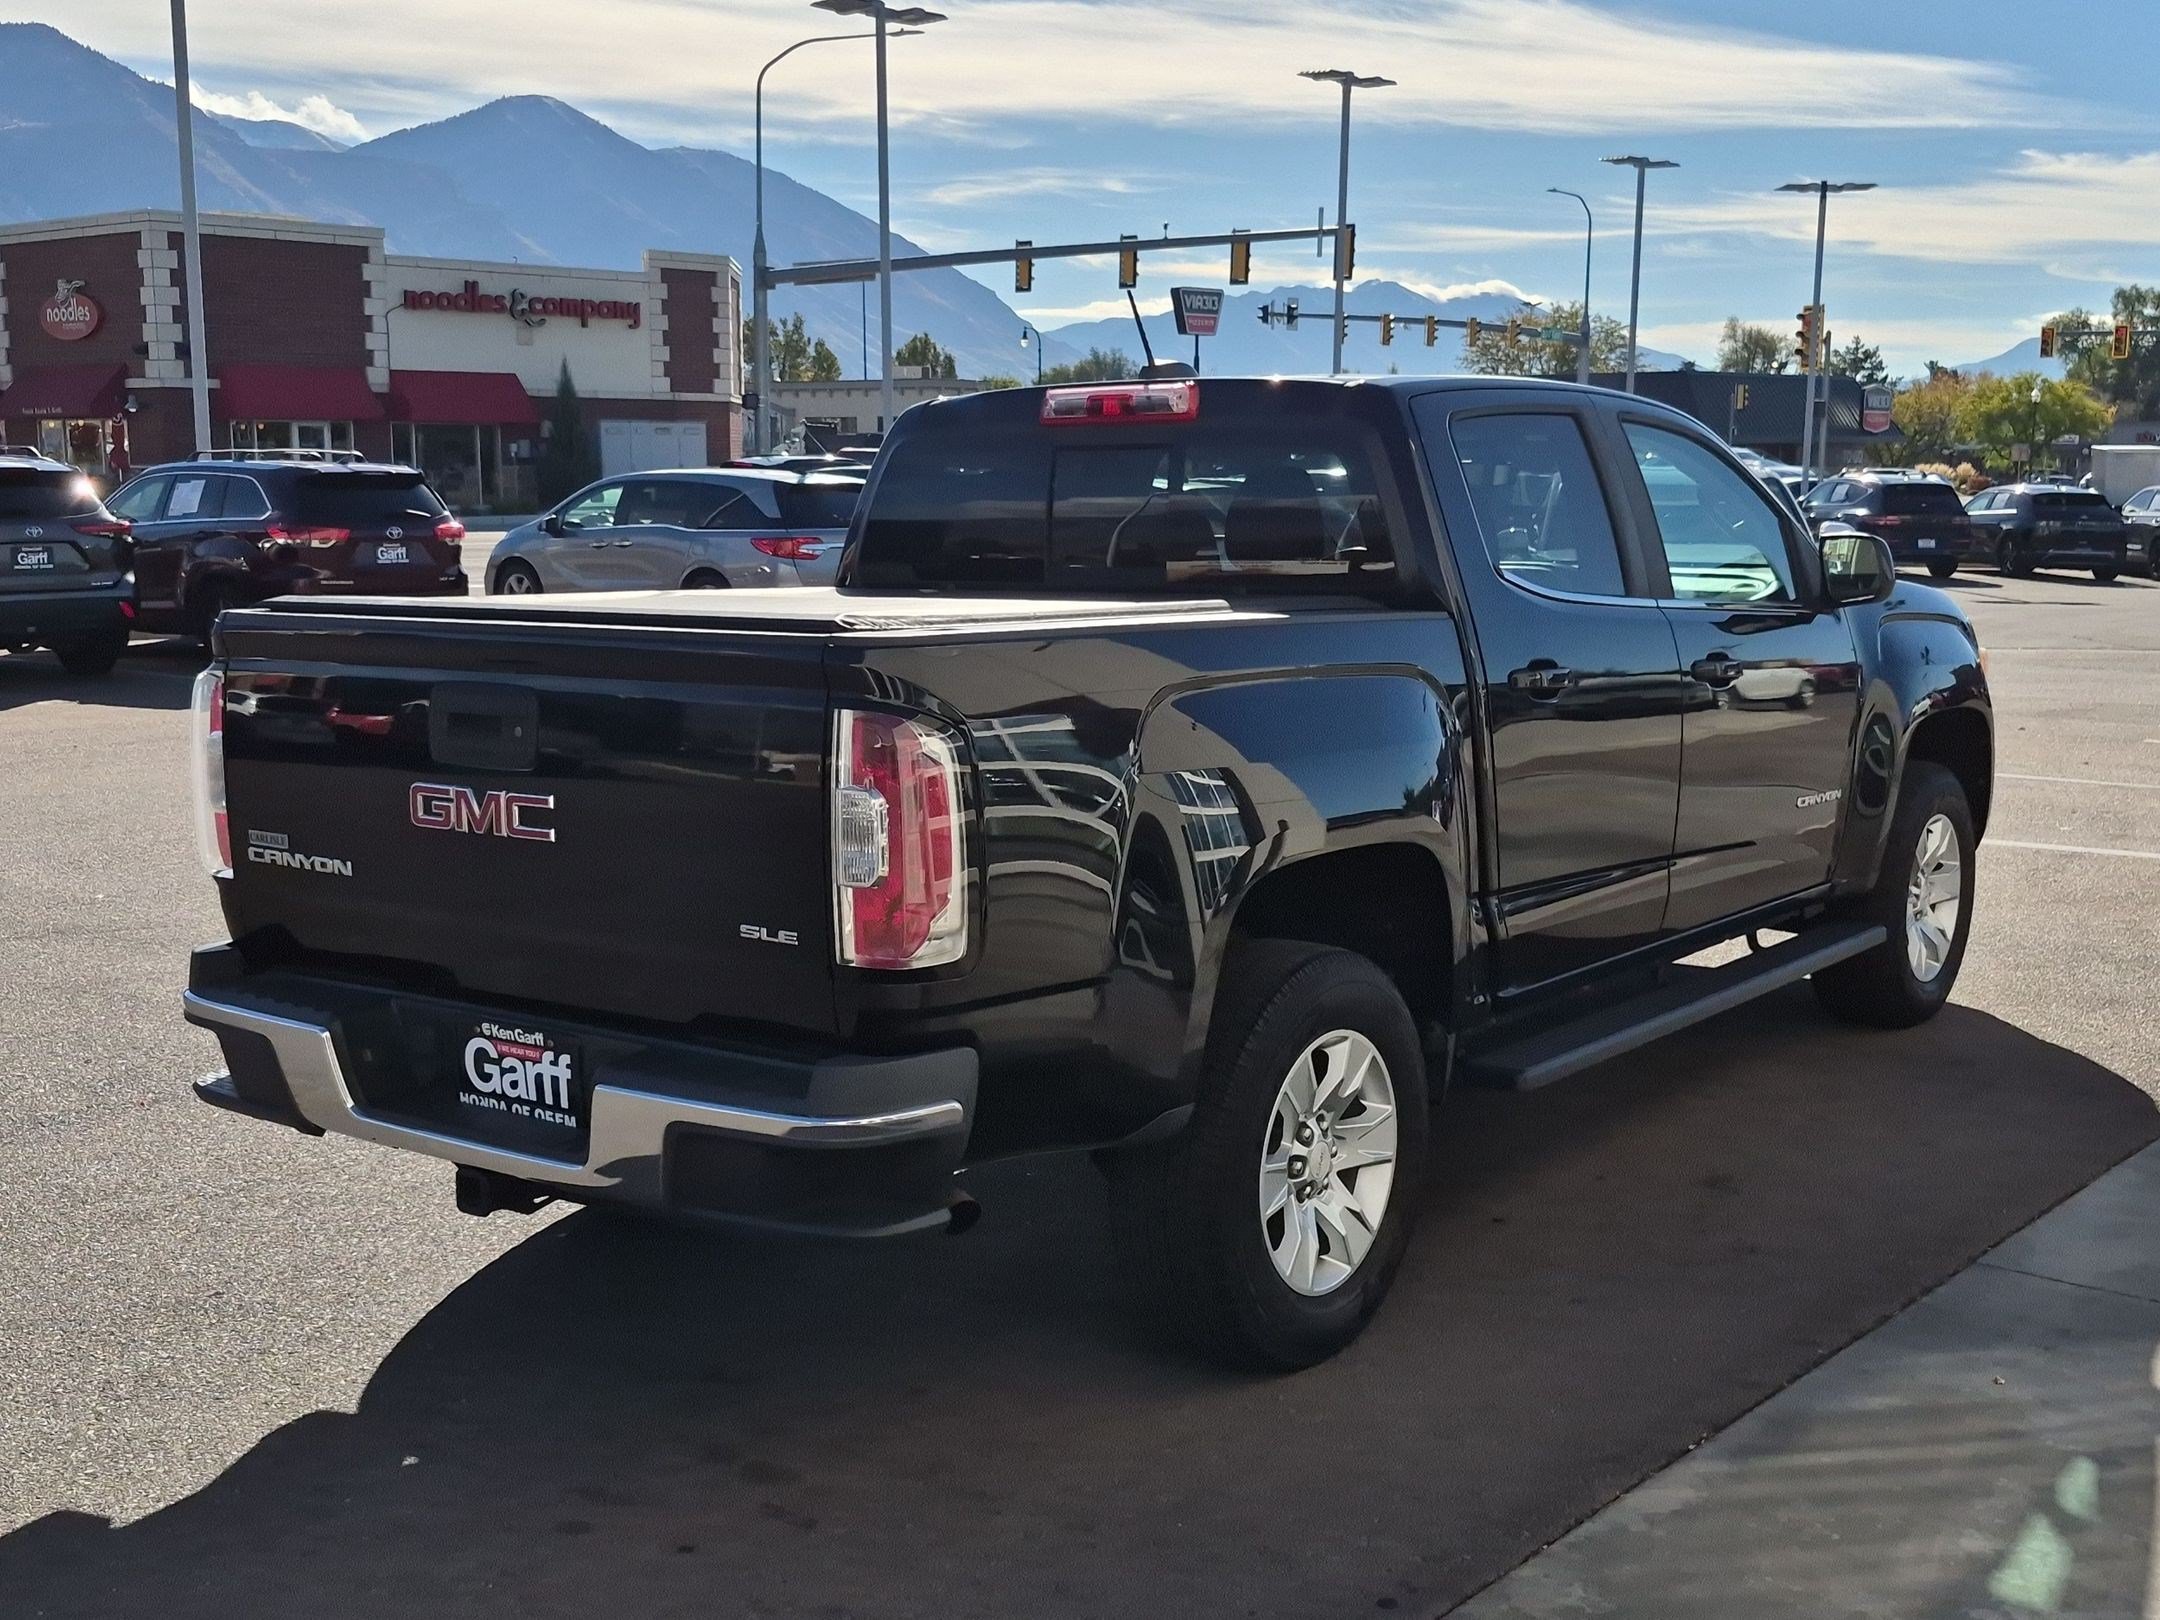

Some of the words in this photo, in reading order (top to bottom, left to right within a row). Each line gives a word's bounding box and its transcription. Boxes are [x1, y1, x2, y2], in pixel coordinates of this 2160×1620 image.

[46, 297, 90, 322] noodles
[403, 280, 509, 313] noodles
[528, 297, 641, 330] company
[1797, 788, 1842, 808] CANYON
[410, 781, 556, 843] GMC
[248, 846, 352, 876] CANYON
[740, 924, 799, 946] SLE
[491, 1023, 515, 1041] Ken
[514, 1028, 545, 1047] Garff
[464, 1037, 572, 1109] Garff
